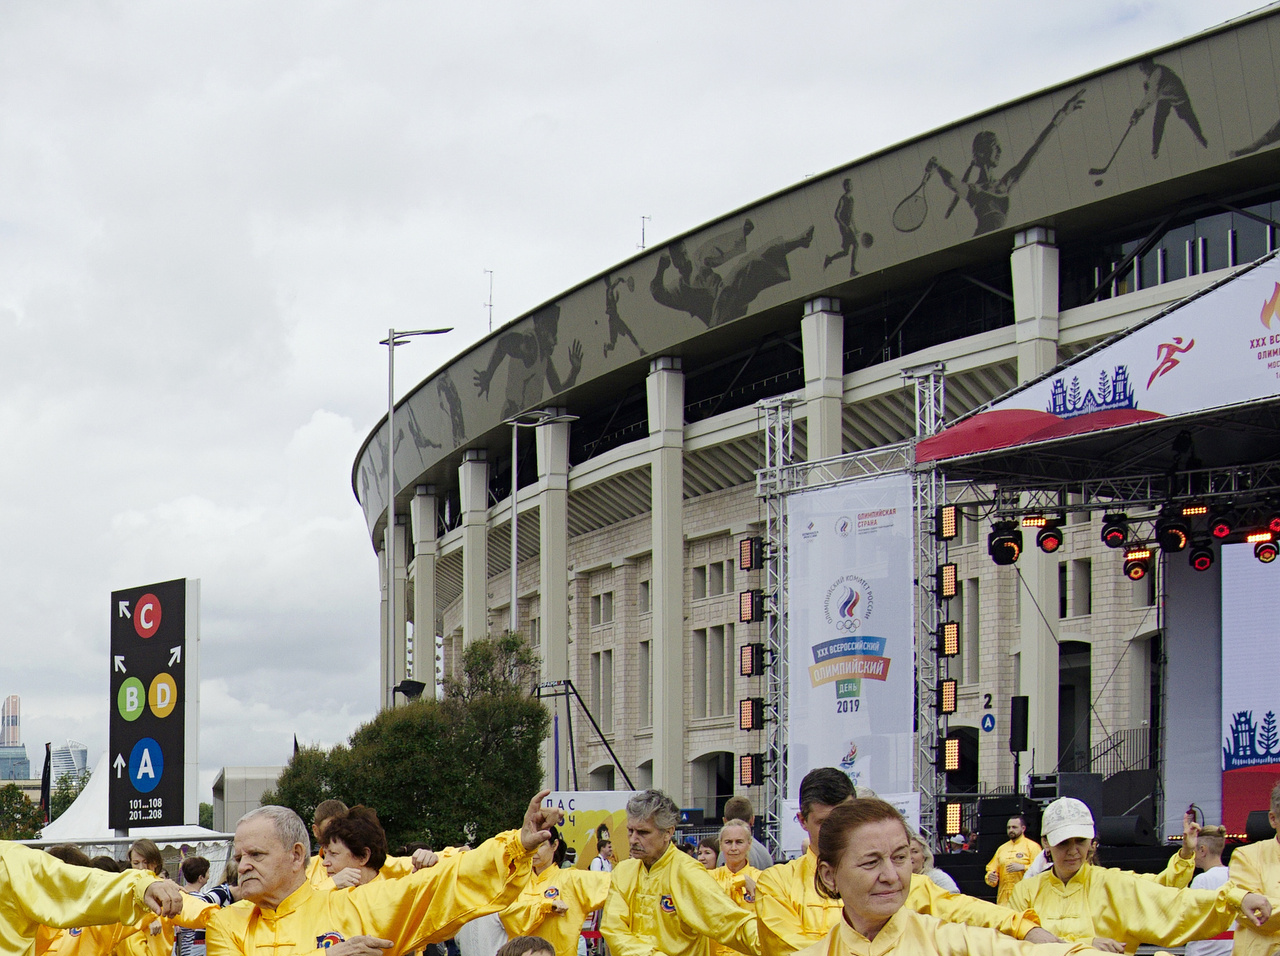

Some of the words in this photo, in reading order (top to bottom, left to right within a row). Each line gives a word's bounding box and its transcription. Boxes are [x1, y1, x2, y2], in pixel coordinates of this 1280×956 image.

[1258, 348, 1280, 360] ОЛИМ
[845, 574, 870, 590] КОМИТЕТ
[140, 603, 153, 629] C
[829, 640, 880, 654] ВСЕРОССИЙСКИЙ
[813, 658, 884, 681] ОЛИМПИЙСКИЙ
[839, 682, 858, 694] ДЕНЬ
[126, 686, 138, 712] B
[157, 683, 170, 708] D
[984, 693, 992, 709] 2
[837, 699, 860, 713] 2019
[984, 716, 992, 728] A
[137, 748, 155, 779] A
